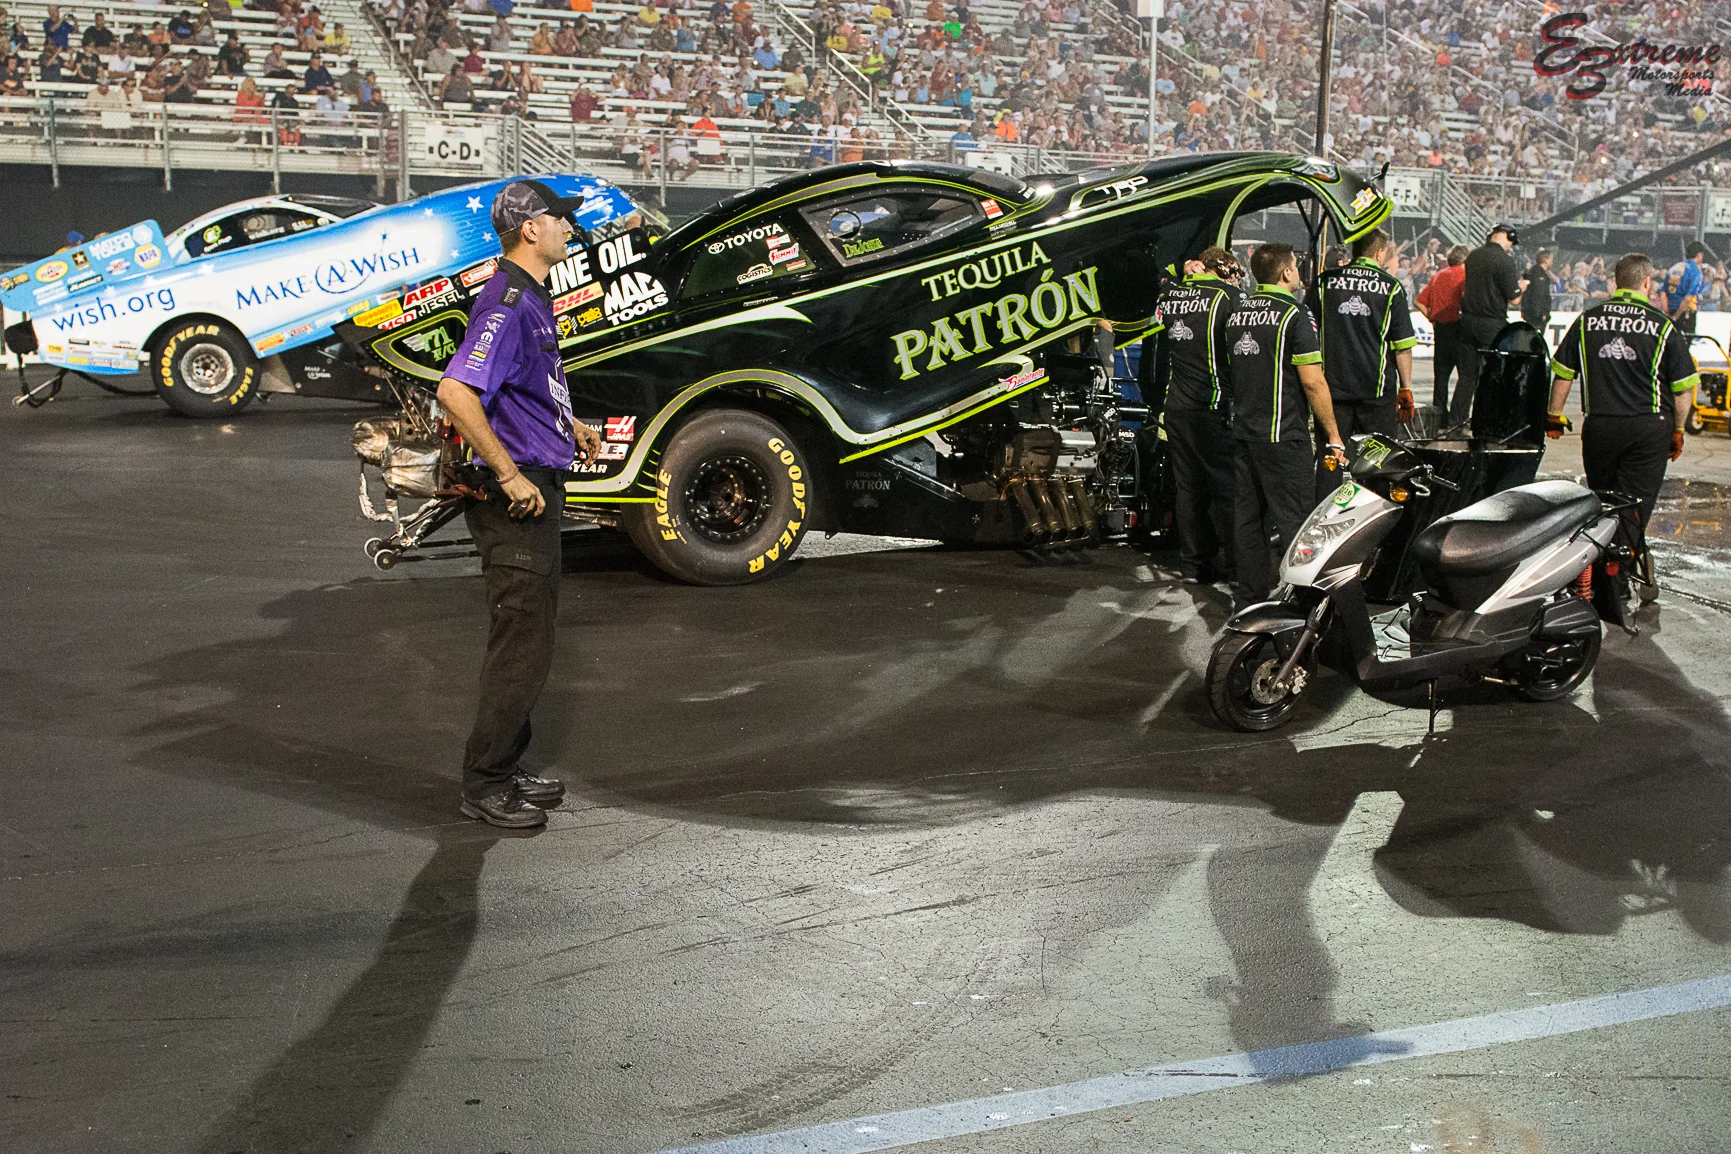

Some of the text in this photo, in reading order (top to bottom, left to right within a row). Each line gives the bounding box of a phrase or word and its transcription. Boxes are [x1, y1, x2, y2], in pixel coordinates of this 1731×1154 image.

[724, 223, 784, 249] TOYOTA
[548, 251, 593, 296] INE
[921, 240, 1052, 302] TEQUILA
[1342, 268, 1380, 278] TEQUILA
[52, 288, 175, 331] wish.org
[404, 278, 450, 308] ARP
[553, 288, 595, 313] DHL
[604, 271, 667, 317] MAC
[606, 293, 669, 326] TOOLS
[1168, 288, 1201, 298] TEQUILA
[1241, 299, 1272, 309] TEQUILA
[1602, 304, 1647, 316] TEQUILA
[890, 266, 1102, 381] PATRÓN
[161, 324, 220, 387] GOODYEAR
[229, 366, 254, 405] EAGLE
[655, 468, 678, 541] EAGLE
[748, 437, 806, 574] GOODYEAR
